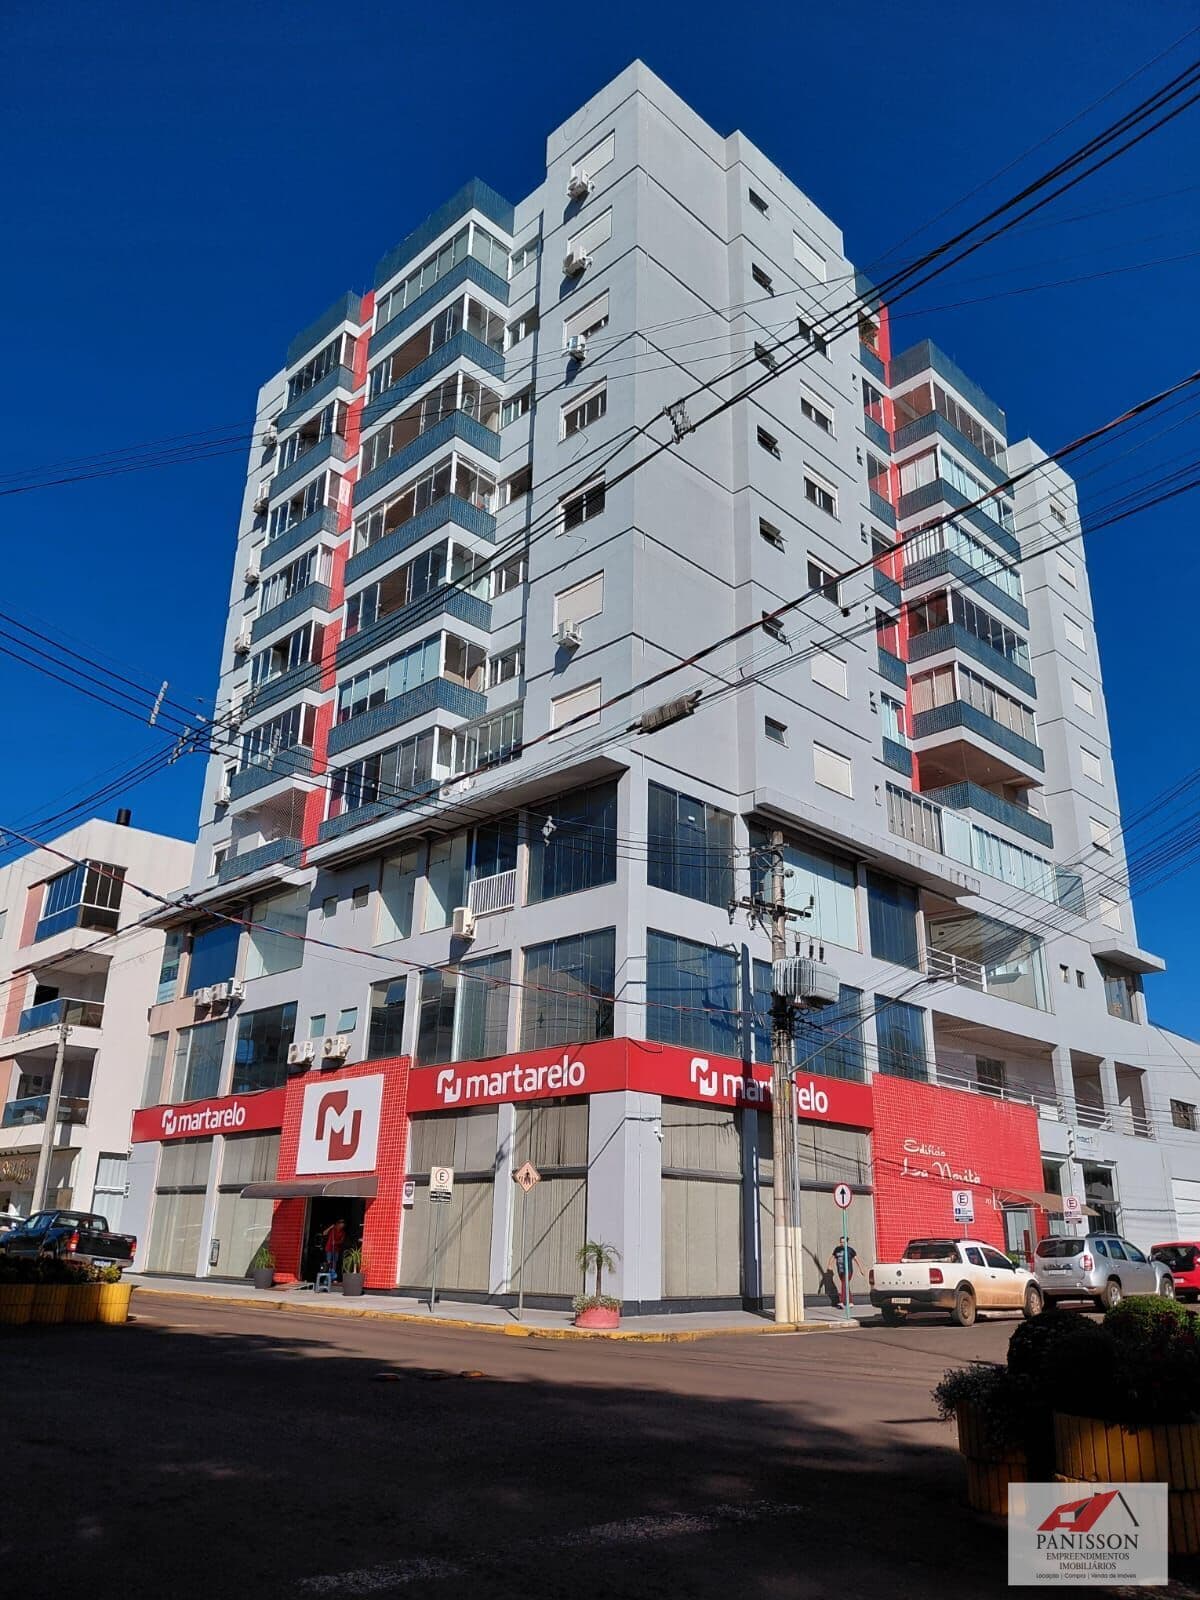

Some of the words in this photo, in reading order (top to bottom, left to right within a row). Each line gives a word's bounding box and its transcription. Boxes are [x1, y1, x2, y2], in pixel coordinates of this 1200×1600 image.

[465, 1055, 585, 1099] martarelo
[722, 1073, 829, 1114] martelo
[178, 1101, 246, 1133] martarelo
